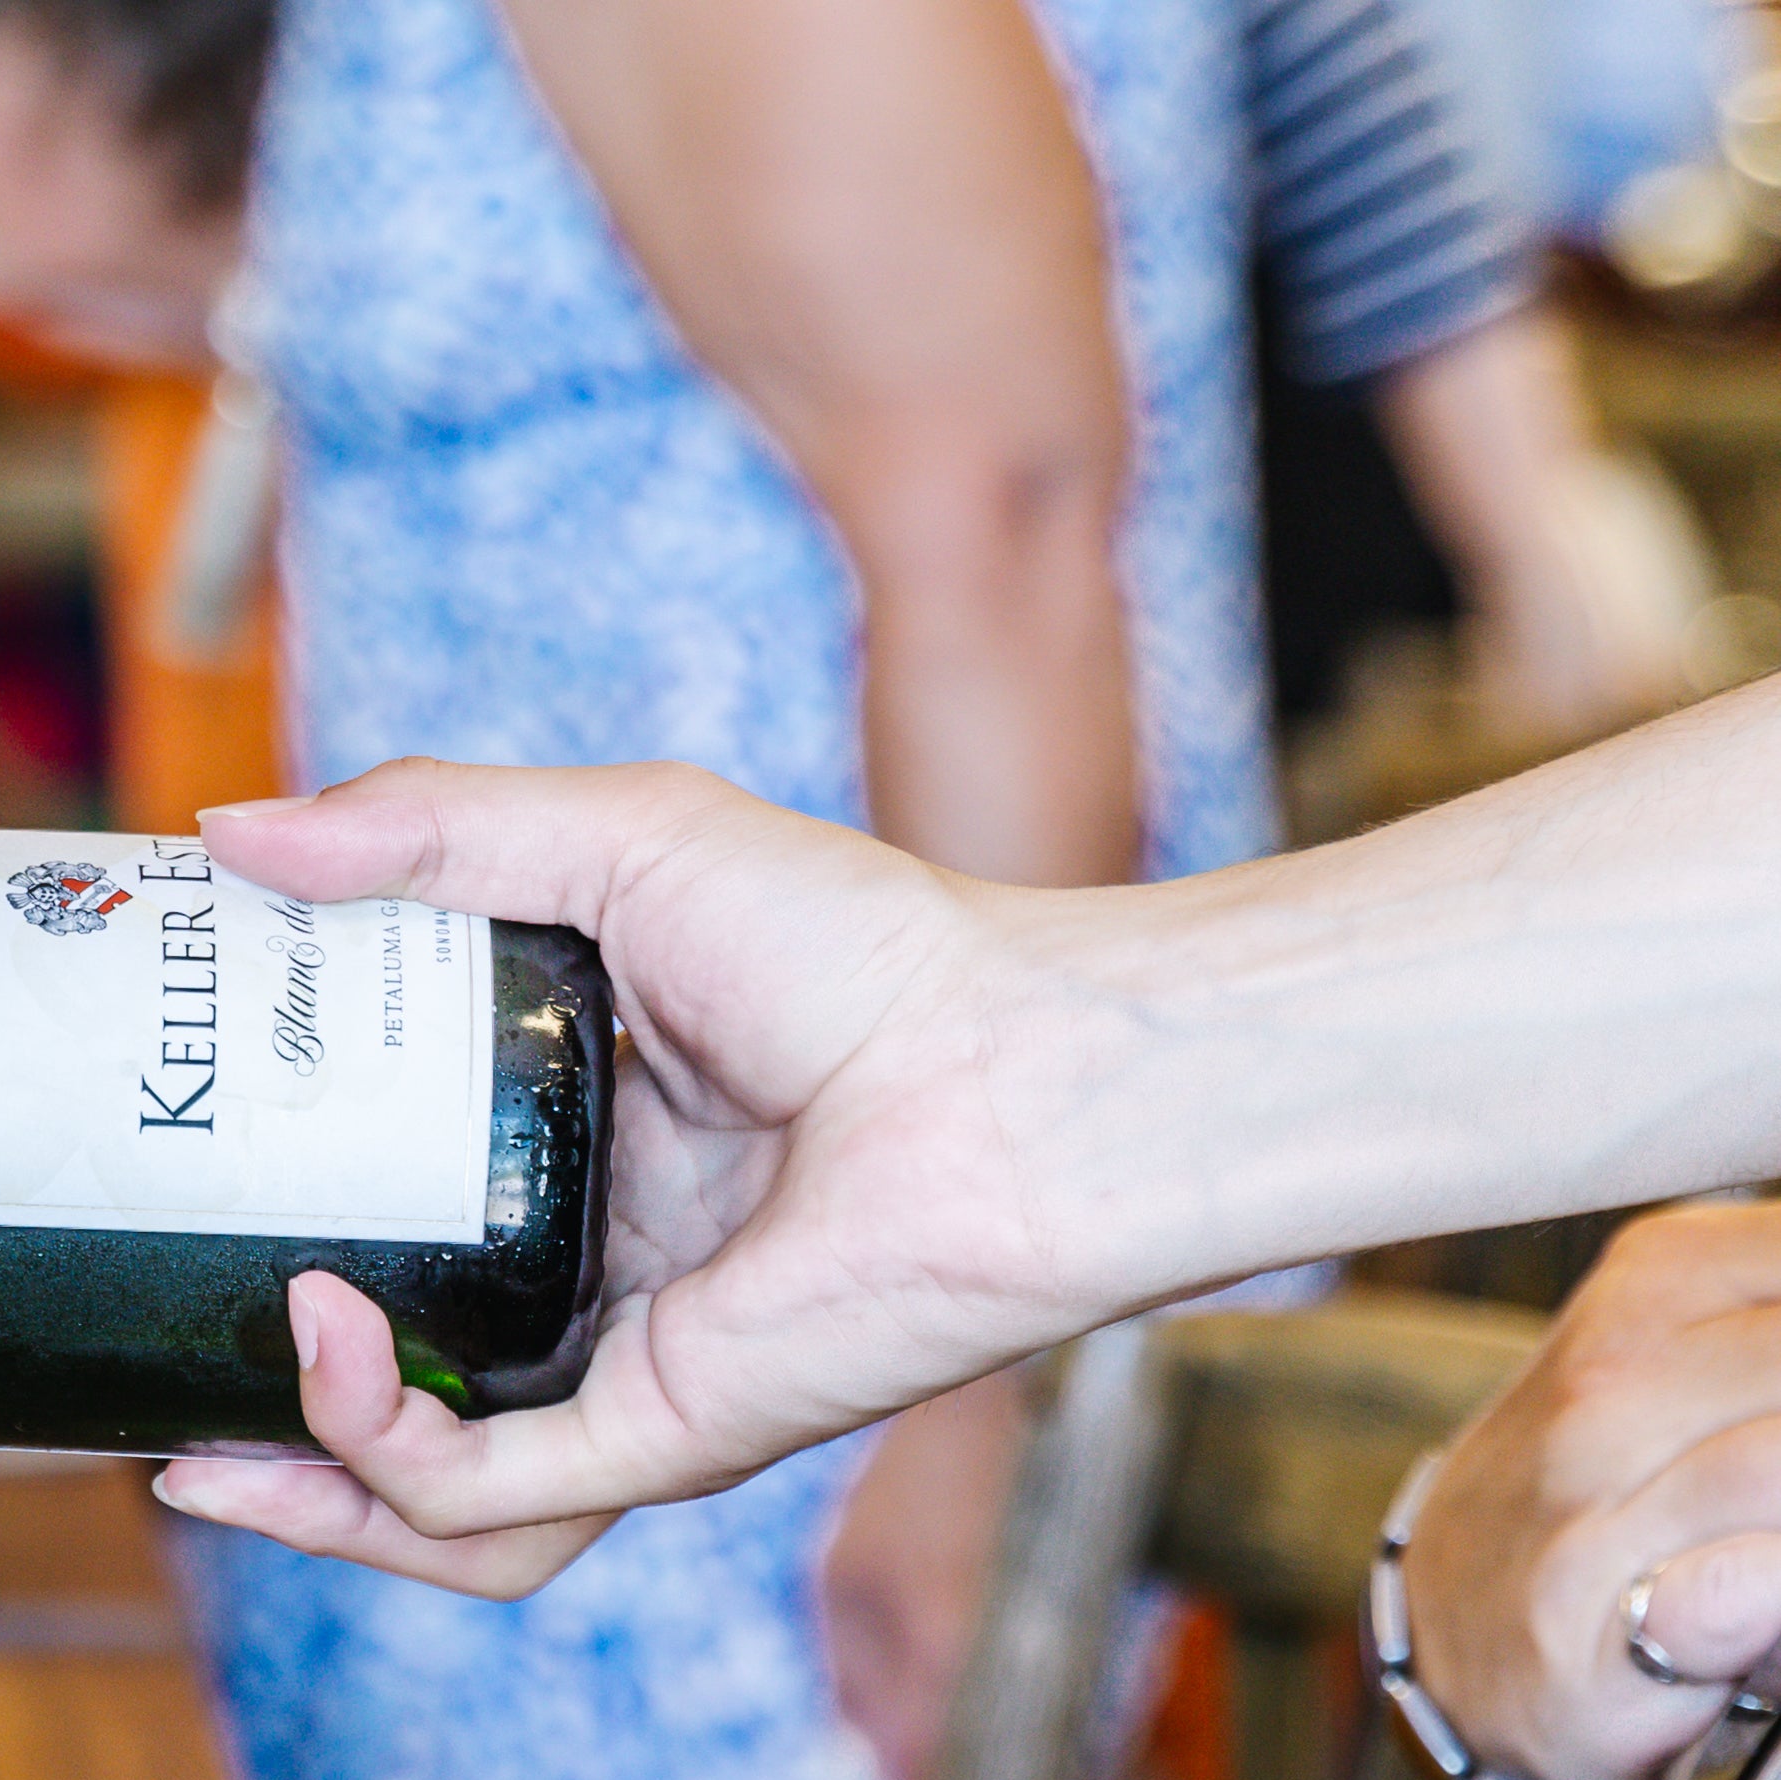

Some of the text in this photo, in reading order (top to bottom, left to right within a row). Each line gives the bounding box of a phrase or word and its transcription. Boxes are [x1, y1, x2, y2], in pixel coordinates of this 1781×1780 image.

[137, 836, 217, 1135] KELLER EST
[383, 925, 403, 1047] PETALUMA
[433, 910, 451, 963] SONOMA
[265, 935, 326, 1077] Blanc
